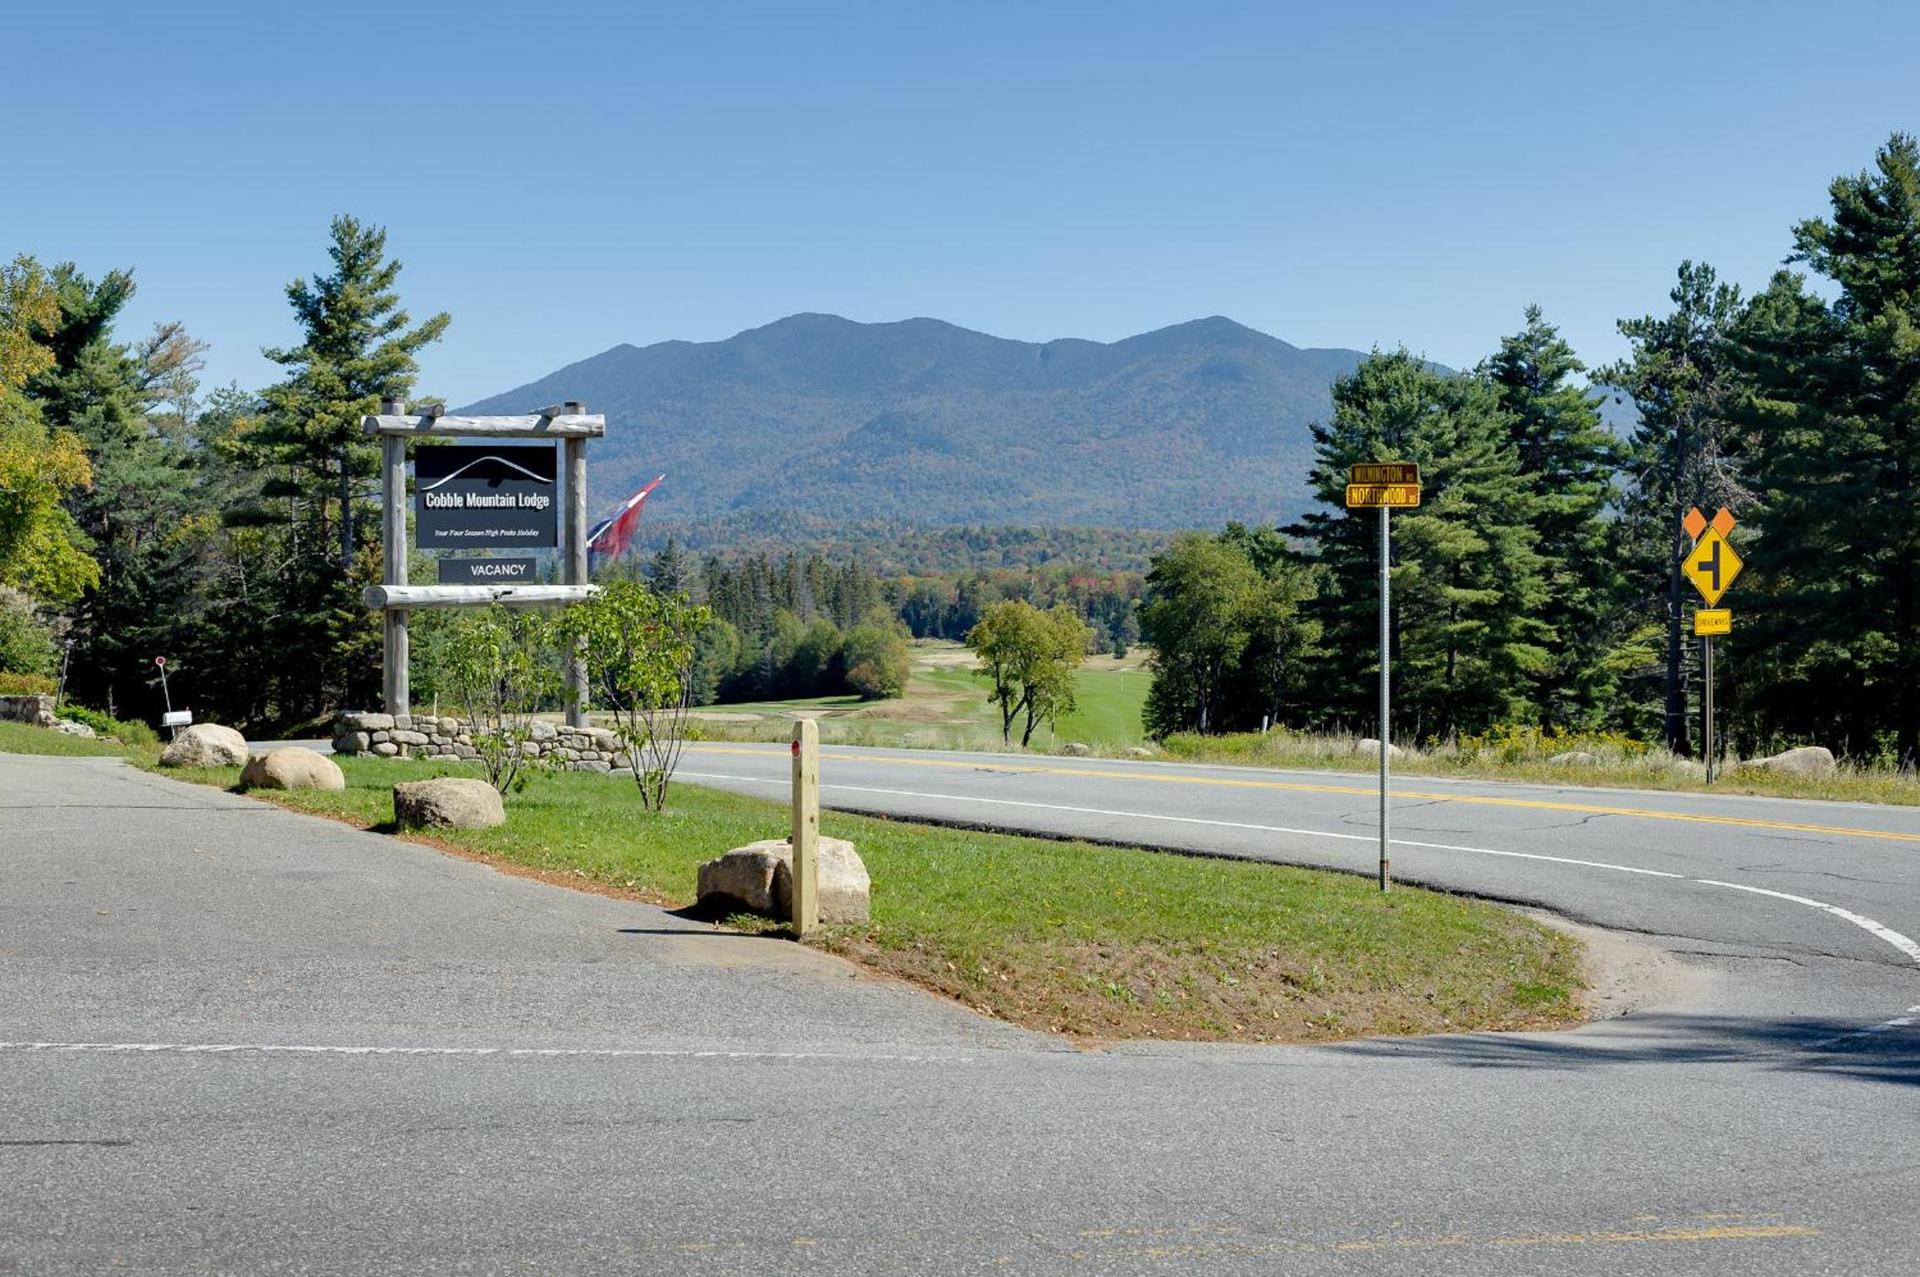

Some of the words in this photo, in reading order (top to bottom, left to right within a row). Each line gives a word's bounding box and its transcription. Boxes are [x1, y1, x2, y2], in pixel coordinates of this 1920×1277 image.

[1355, 466, 1402, 482] WILMINGTON
[426, 492, 463, 508] Cobble
[466, 493, 516, 508] Mountain
[518, 493, 549, 510] Lodge
[1352, 487, 1406, 504] NORTHWOOD
[434, 529, 449, 537] Your
[471, 564, 526, 576] VACANCY
